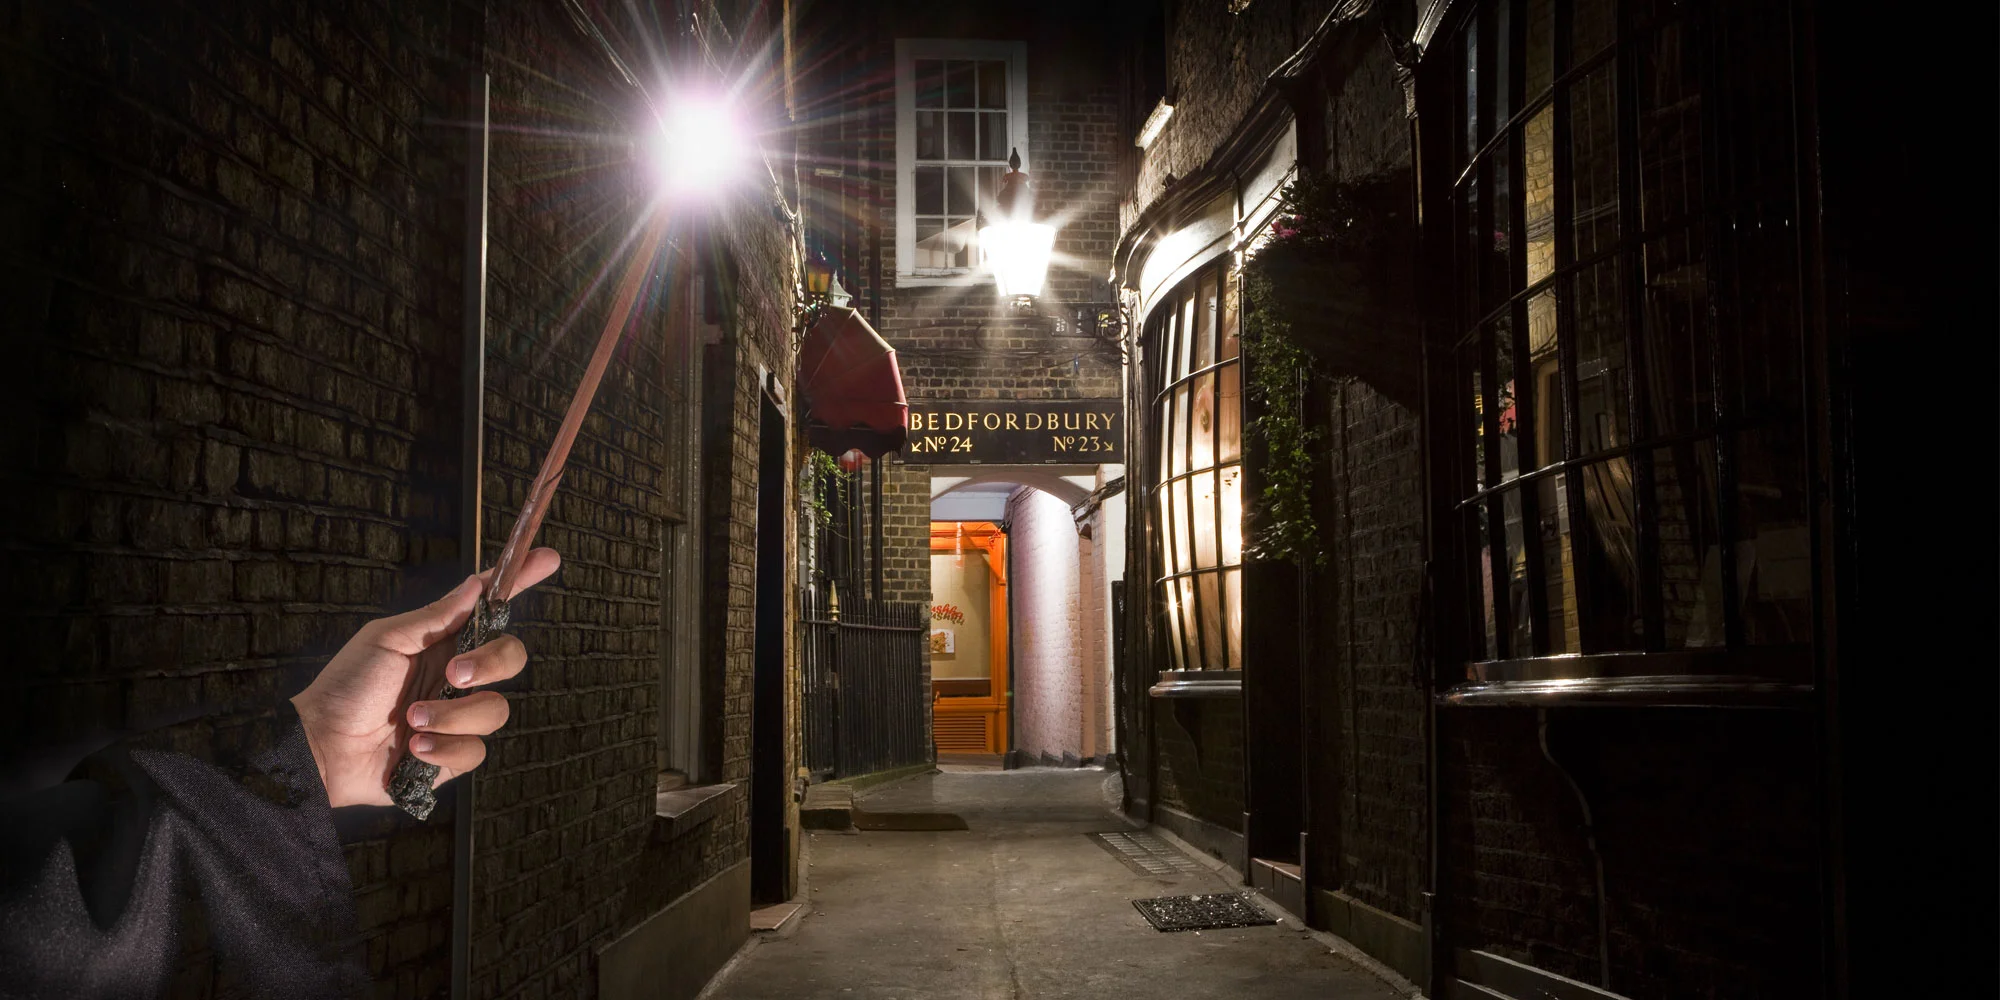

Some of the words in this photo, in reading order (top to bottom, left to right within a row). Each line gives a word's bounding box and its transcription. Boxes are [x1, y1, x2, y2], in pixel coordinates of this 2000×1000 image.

[910, 412, 1116, 431] BEDFORDBURY
[950, 436, 973, 453] 24
[1078, 436, 1100, 453] 23
